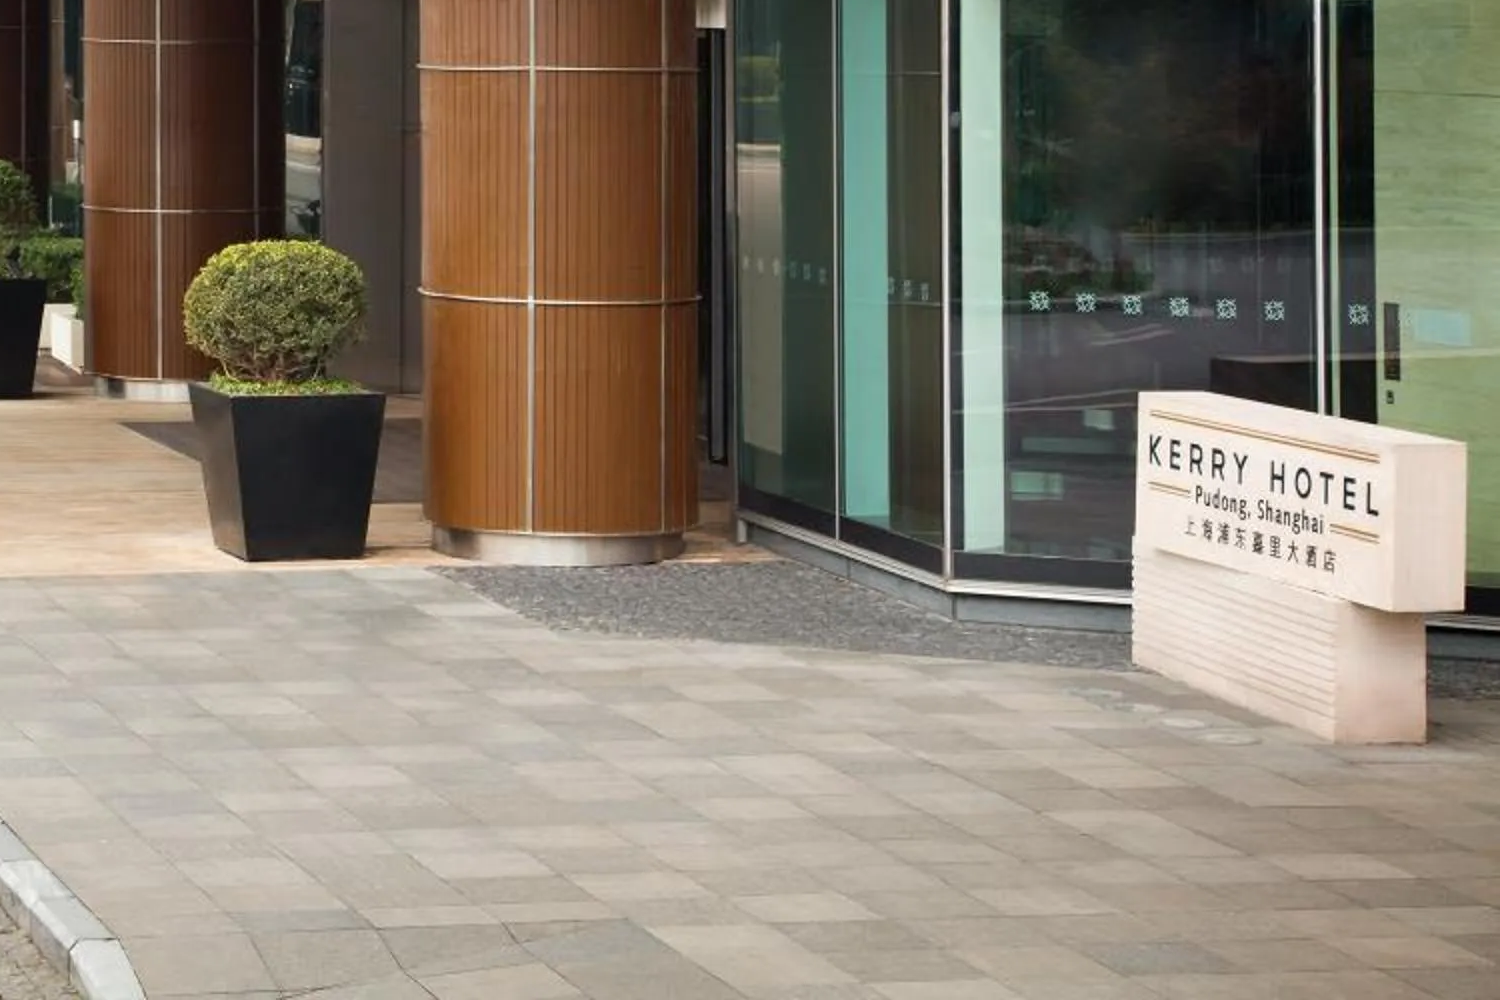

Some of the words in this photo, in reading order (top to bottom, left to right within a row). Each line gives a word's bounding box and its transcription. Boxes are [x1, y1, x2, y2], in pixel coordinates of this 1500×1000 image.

[1149, 433, 1248, 485] KERRY
[1269, 459, 1380, 517] HOTEL
[1194, 484, 1252, 521] Pudong,
[1256, 499, 1325, 535] Shanghai
